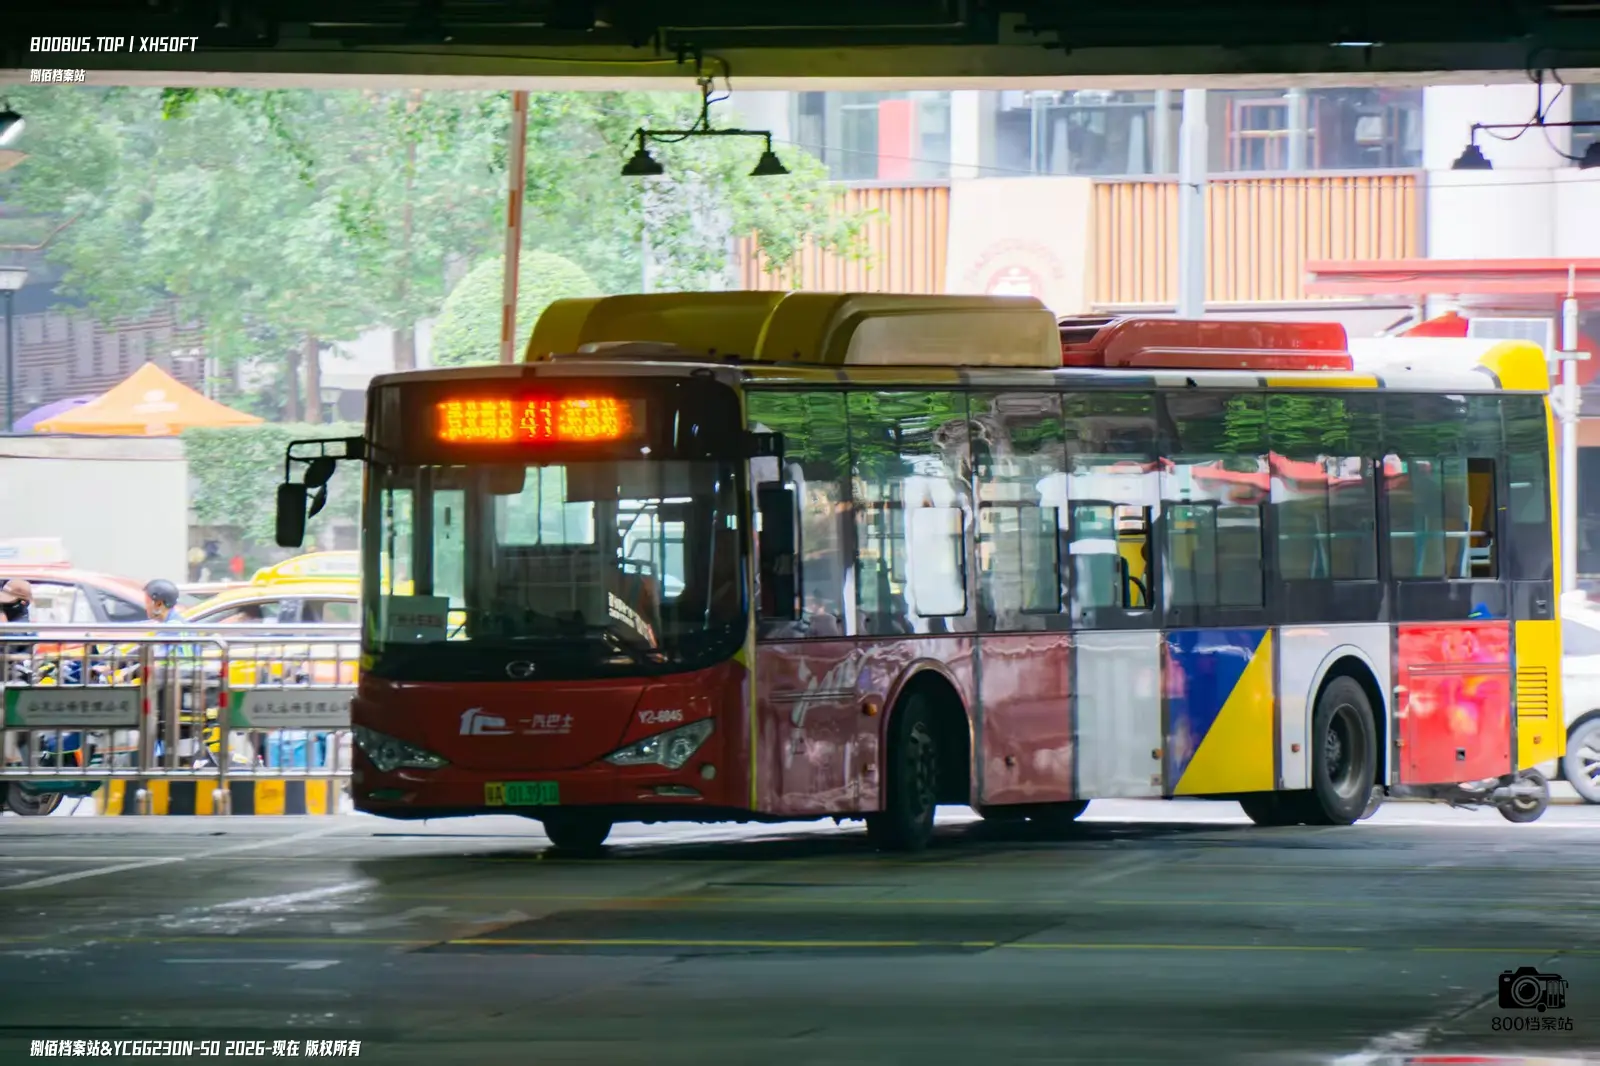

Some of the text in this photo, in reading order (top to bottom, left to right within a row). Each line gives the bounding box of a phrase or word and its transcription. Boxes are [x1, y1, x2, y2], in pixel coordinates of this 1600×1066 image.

[519, 400, 553, 439] 41
[518, 713, 575, 728] 一汽巴士
